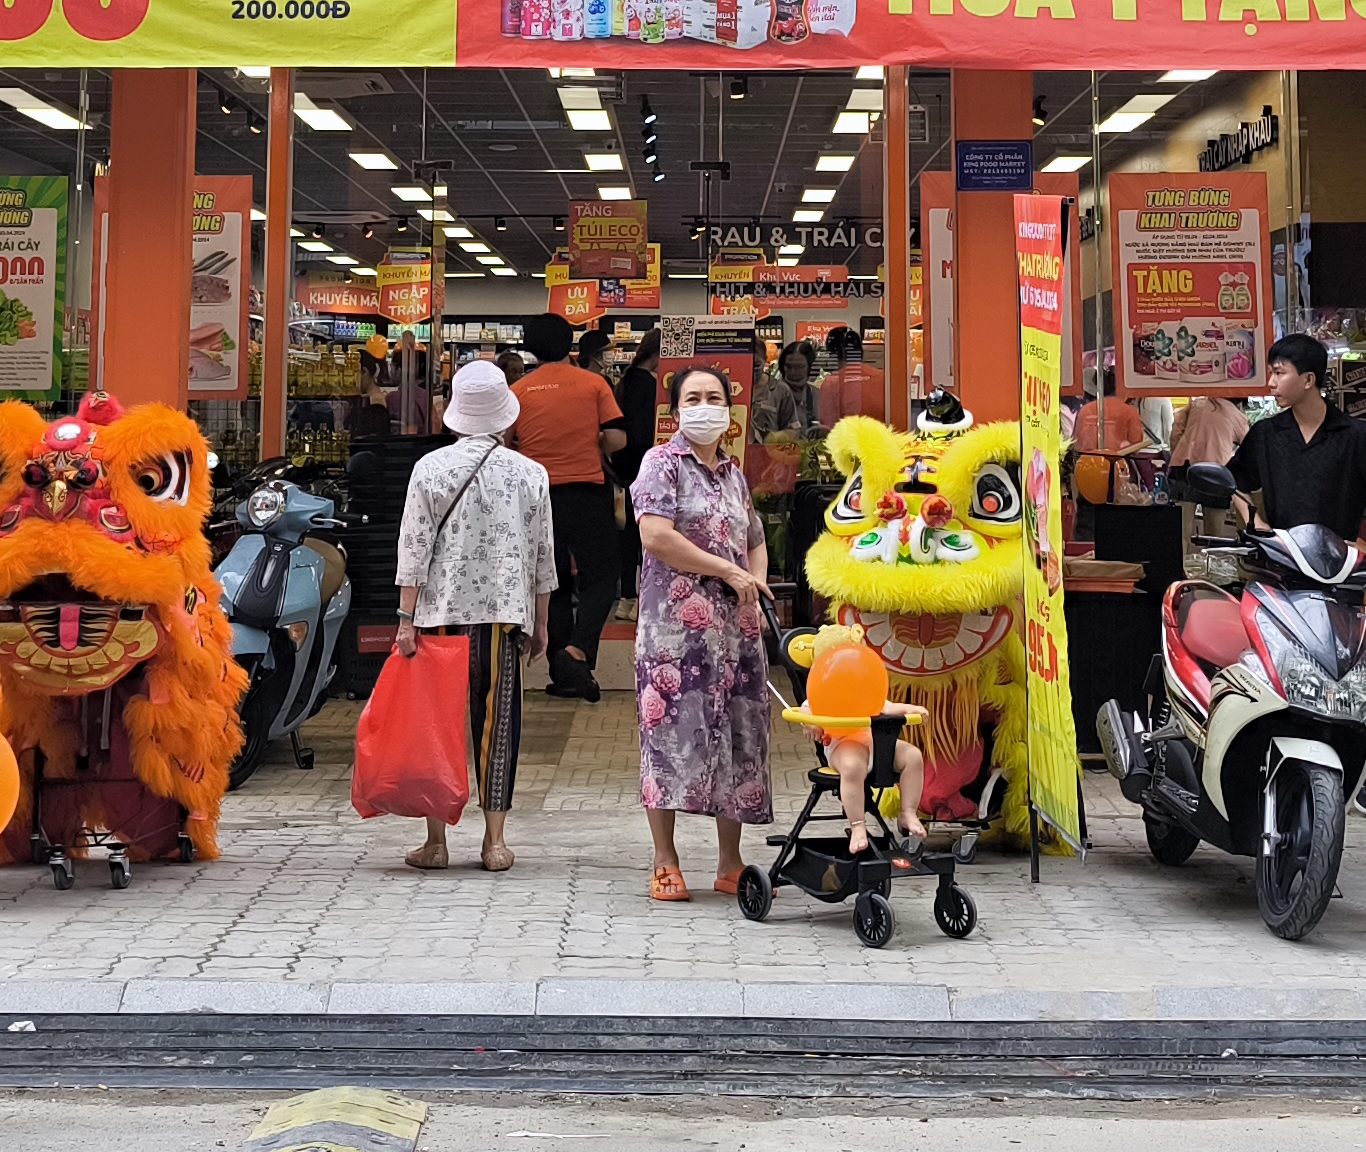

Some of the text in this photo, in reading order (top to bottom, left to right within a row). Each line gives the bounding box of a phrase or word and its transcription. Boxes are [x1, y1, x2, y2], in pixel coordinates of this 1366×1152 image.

[1139, 211, 1177, 229] KHAI
[608, 224, 641, 237] ECO
[710, 220, 856, 248] RAU & TRÁI
[17, 239, 41, 252] CÂY
[1132, 265, 1194, 297] TẶNG
[309, 289, 358, 307] KHUYẾN
